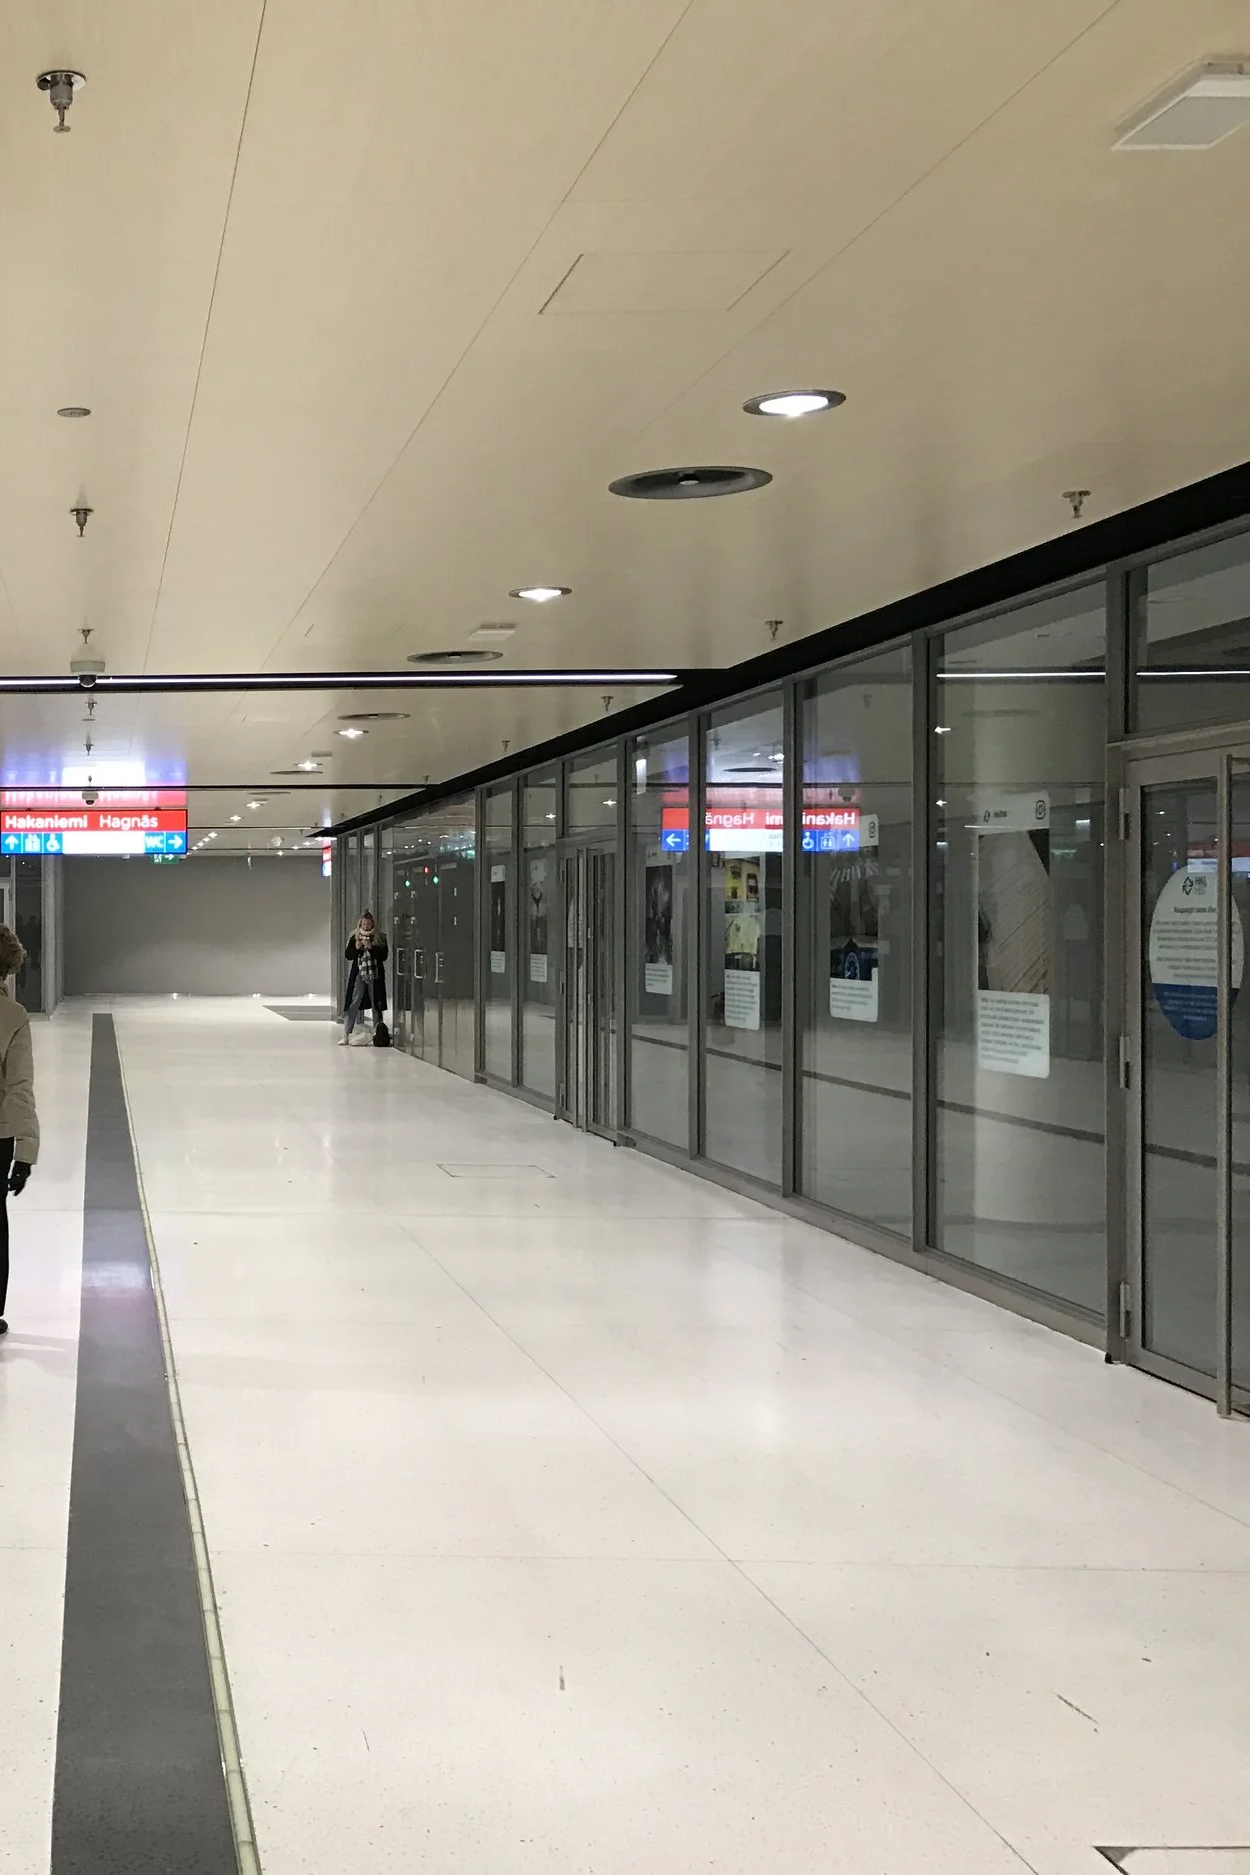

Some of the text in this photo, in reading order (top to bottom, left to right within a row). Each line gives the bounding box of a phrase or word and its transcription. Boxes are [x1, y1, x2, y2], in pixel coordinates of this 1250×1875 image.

[5, 815, 158, 831] Hakaniemi Hagnäs
[145, 836, 164, 848] WC
